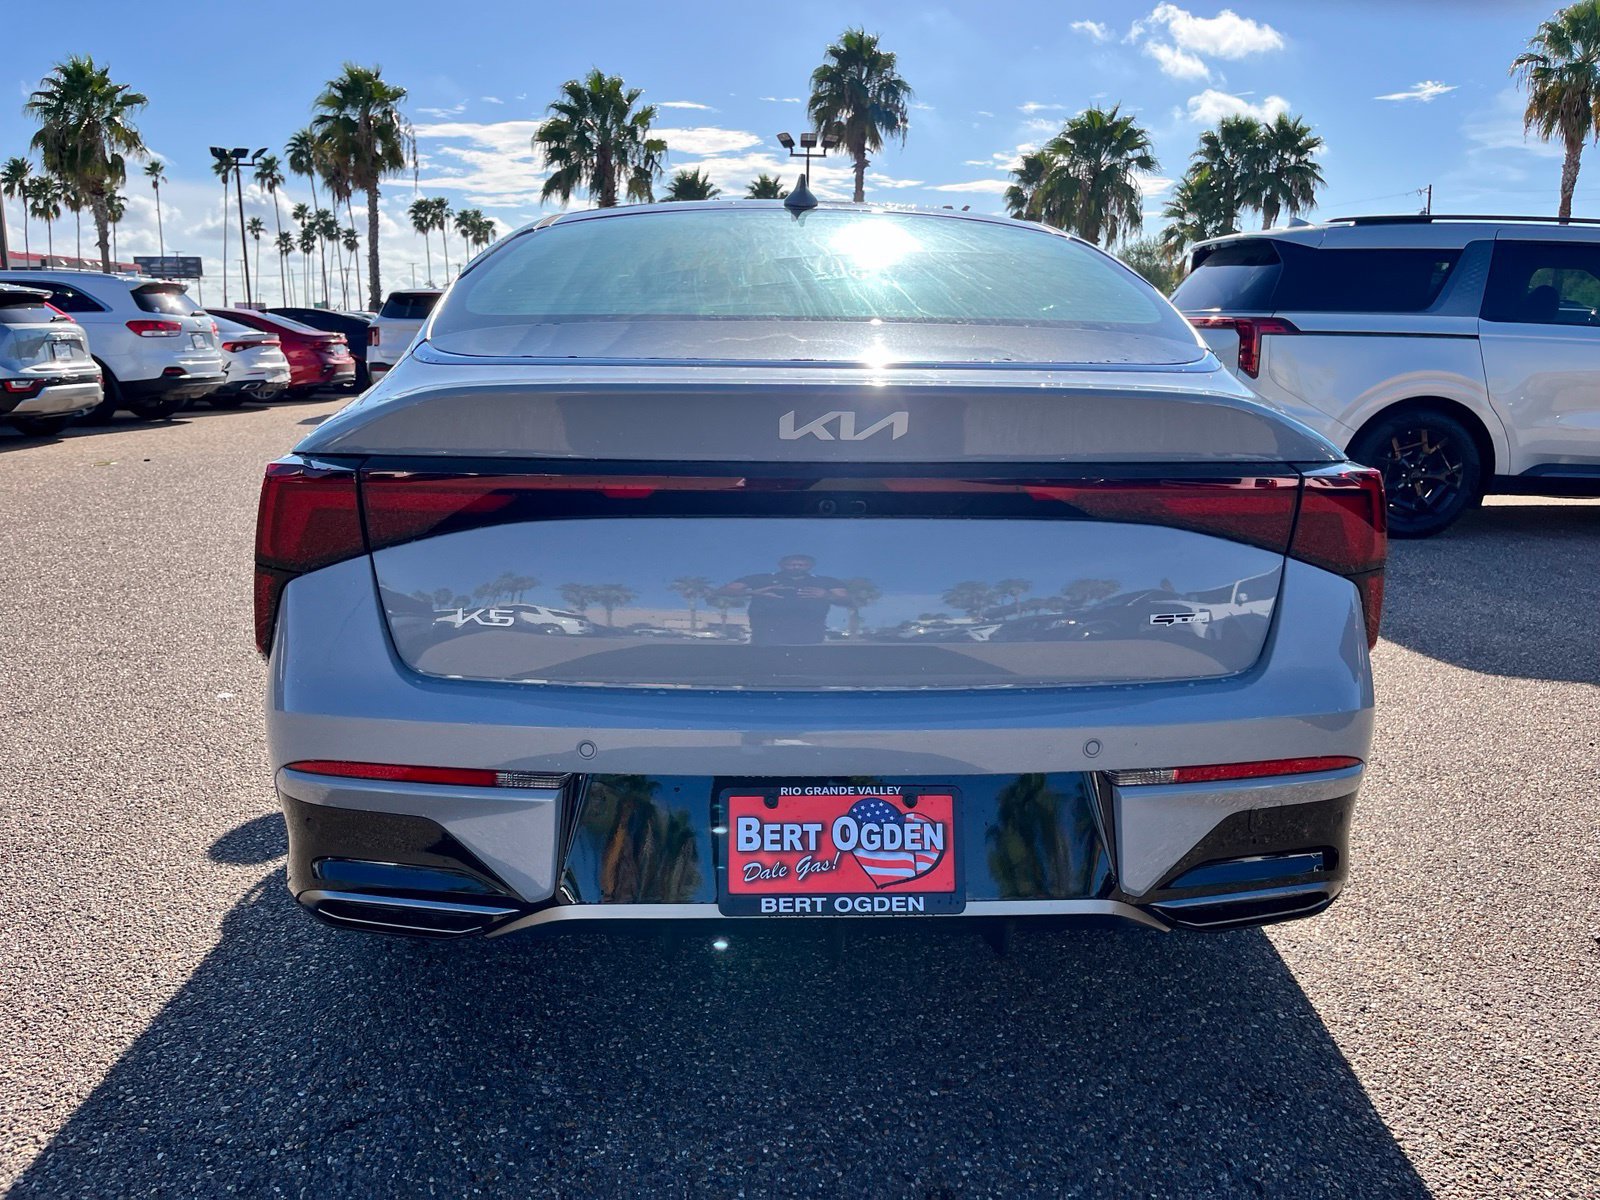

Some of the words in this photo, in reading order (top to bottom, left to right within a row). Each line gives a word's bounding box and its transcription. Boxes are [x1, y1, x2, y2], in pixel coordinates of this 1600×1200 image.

[779, 410, 909, 441] KIA
[454, 607, 515, 629] K5
[780, 786, 802, 796] RIO
[804, 786, 855, 796] GRANDE
[857, 786, 901, 795] VALLEY
[736, 816, 822, 852] BERT
[831, 815, 944, 851] OGDEN
[743, 861, 788, 882] Dale
[795, 851, 841, 880] Gas!
[760, 897, 827, 913] BERT
[834, 896, 925, 912] OGDEN
